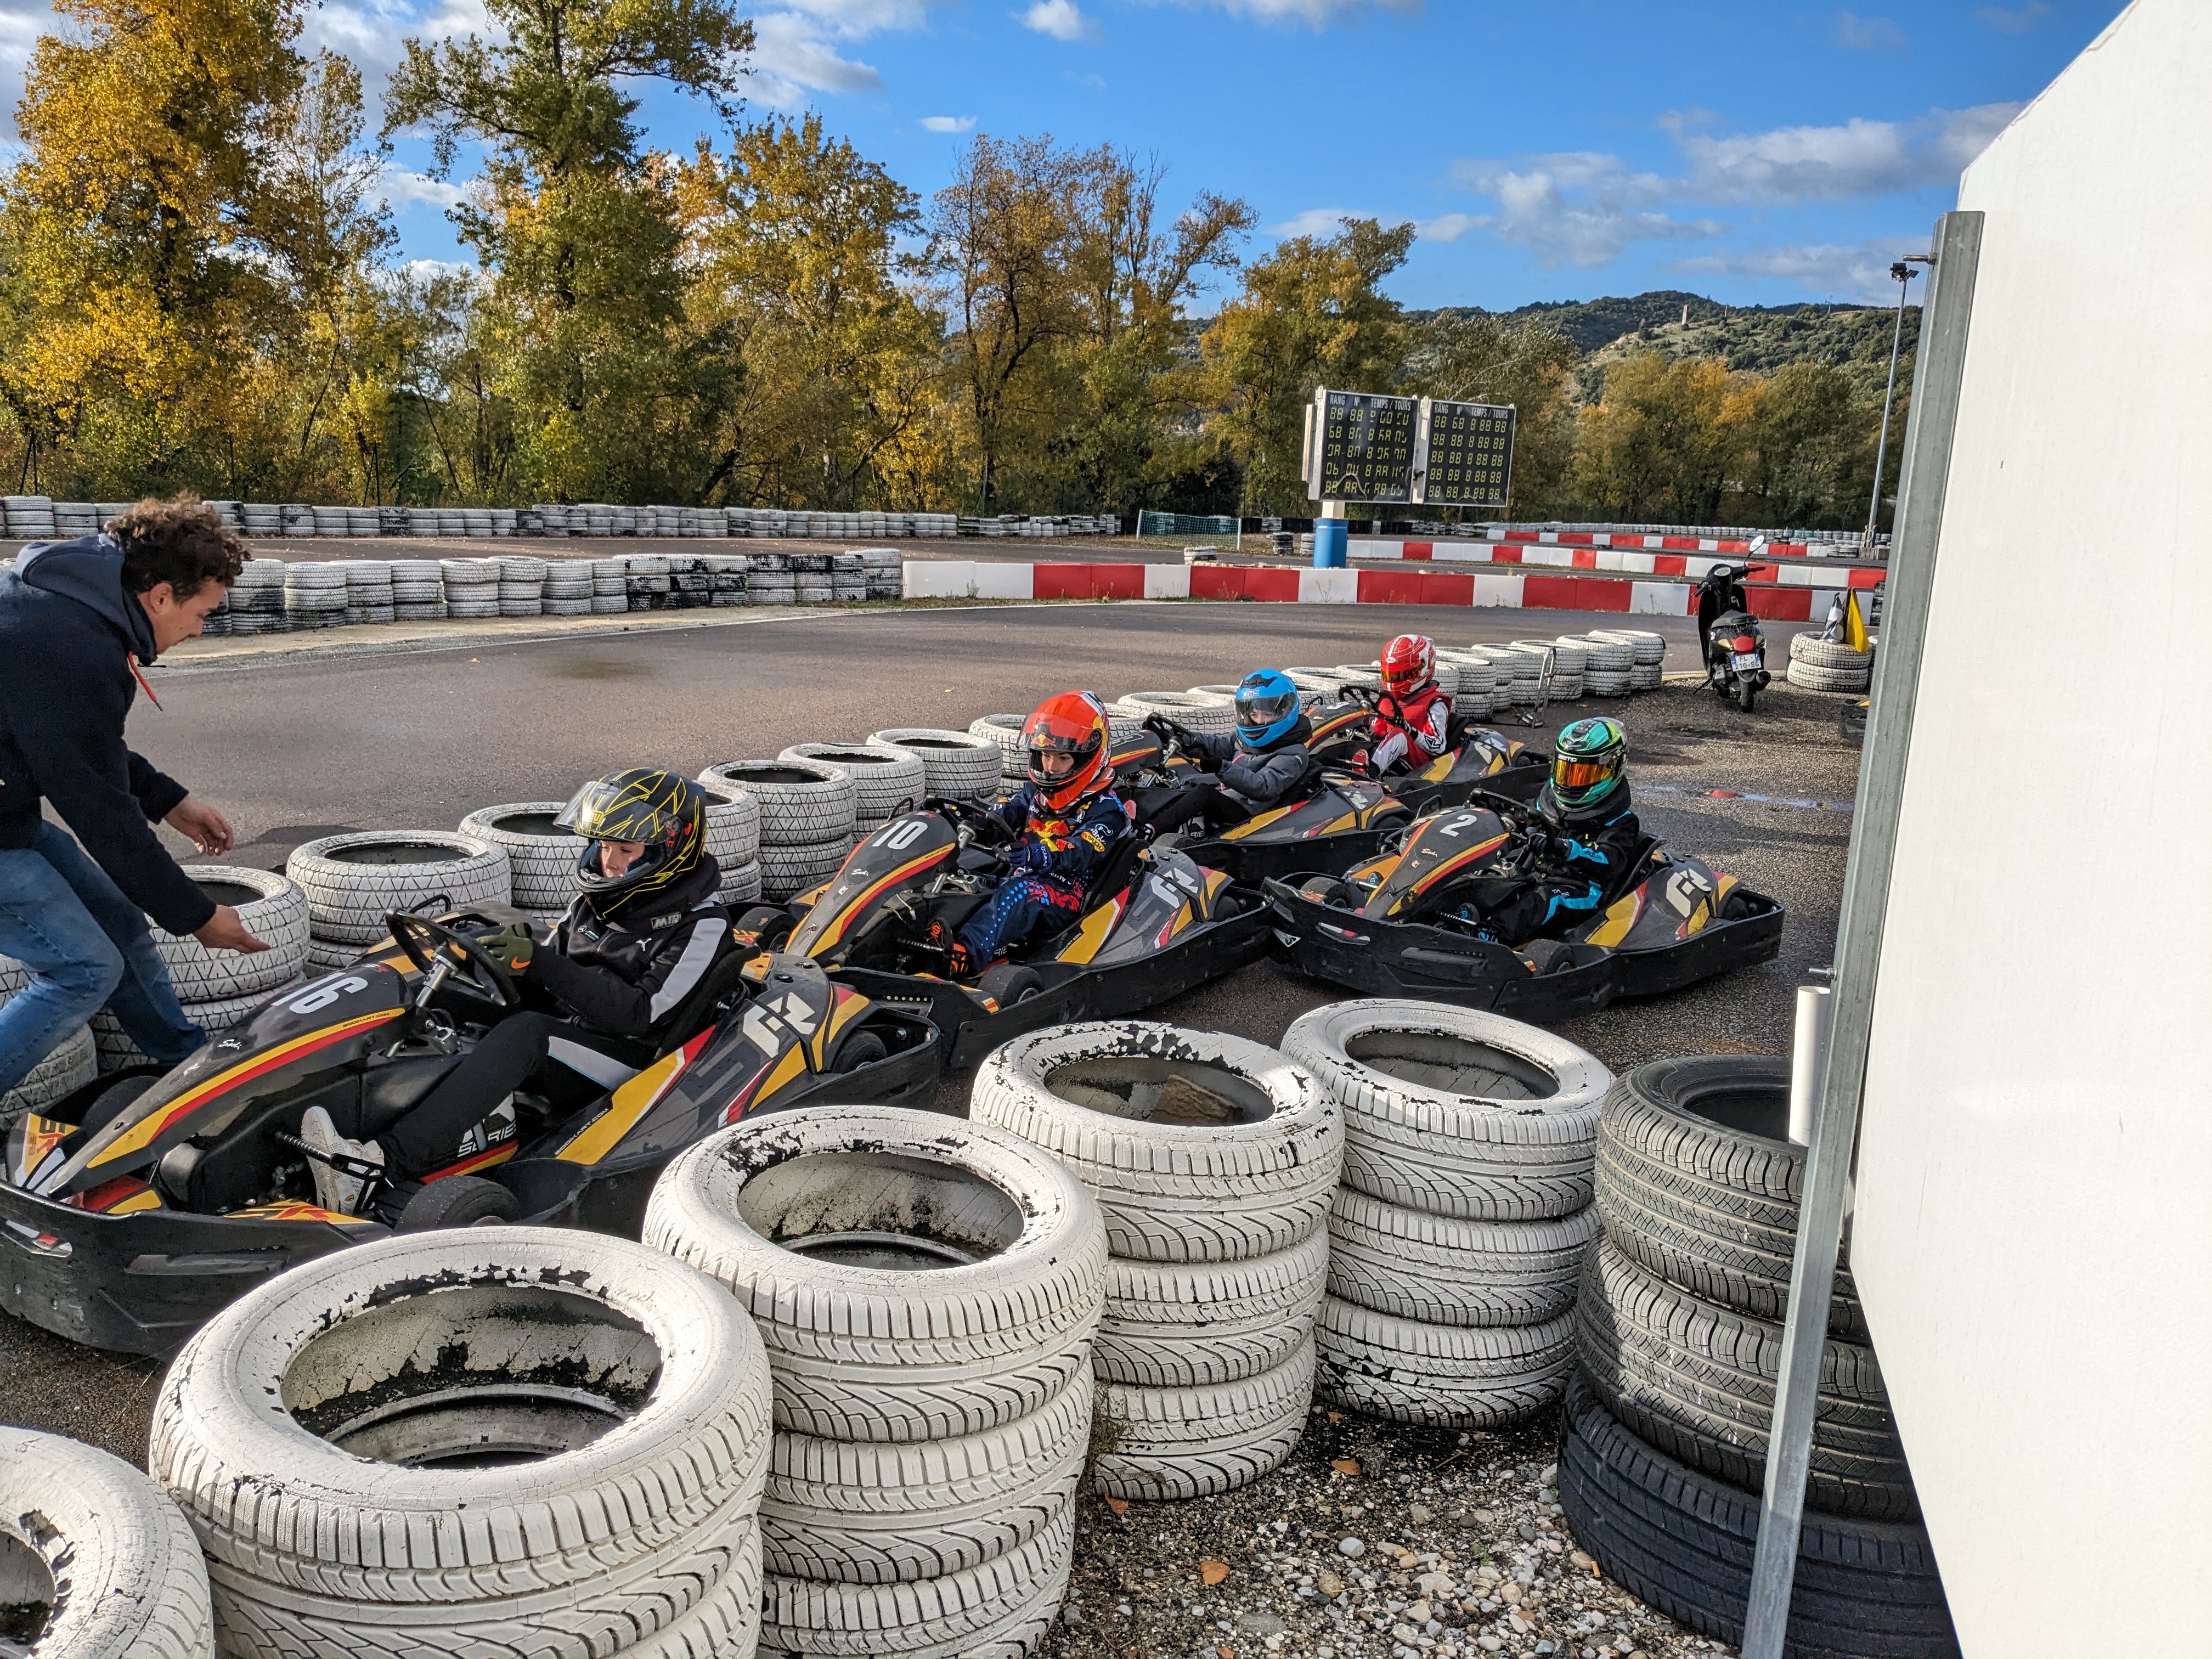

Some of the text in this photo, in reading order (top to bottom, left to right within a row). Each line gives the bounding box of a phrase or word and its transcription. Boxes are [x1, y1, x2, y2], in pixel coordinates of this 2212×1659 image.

[1330, 394, 1345, 405] RANG
[1371, 398, 1388, 409] TEMPS
[1395, 400, 1411, 411] TOURS
[1435, 404, 1448, 414] RANG
[1471, 408, 1487, 417] TEMPS
[1493, 410, 1508, 419] TOURS
[1434, 415, 1447, 428] 88
[1480, 420, 1491, 431] 88
[1494, 421, 1506, 433] 88
[1433, 433, 1445, 445] 88
[1451, 435, 1463, 447] 88
[1478, 437, 1489, 448] 88
[1493, 438, 1504, 449] 88
[1431, 451, 1443, 462] 88
[1449, 452, 1462, 464] 88
[1476, 454, 1488, 465] 88
[1492, 455, 1503, 466] 88
[1430, 468, 1442, 480] 88
[1448, 469, 1460, 481] 88
[1475, 471, 1486, 482] 88
[1490, 471, 1502, 483] 88
[1429, 486, 1441, 498] 88
[1446, 486, 1458, 498] 88
[1473, 488, 1485, 499] 88
[1488, 488, 1500, 500] 88
[1734, 661, 1759, 669] 210-SG
[1558, 754, 1577, 763] zamp
[1440, 814, 1477, 837] 2
[872, 820, 928, 850] 10
[1088, 835, 1102, 849] RAUCH
[271, 972, 368, 1014] 16
[218, 1039, 242, 1049] Sodi
